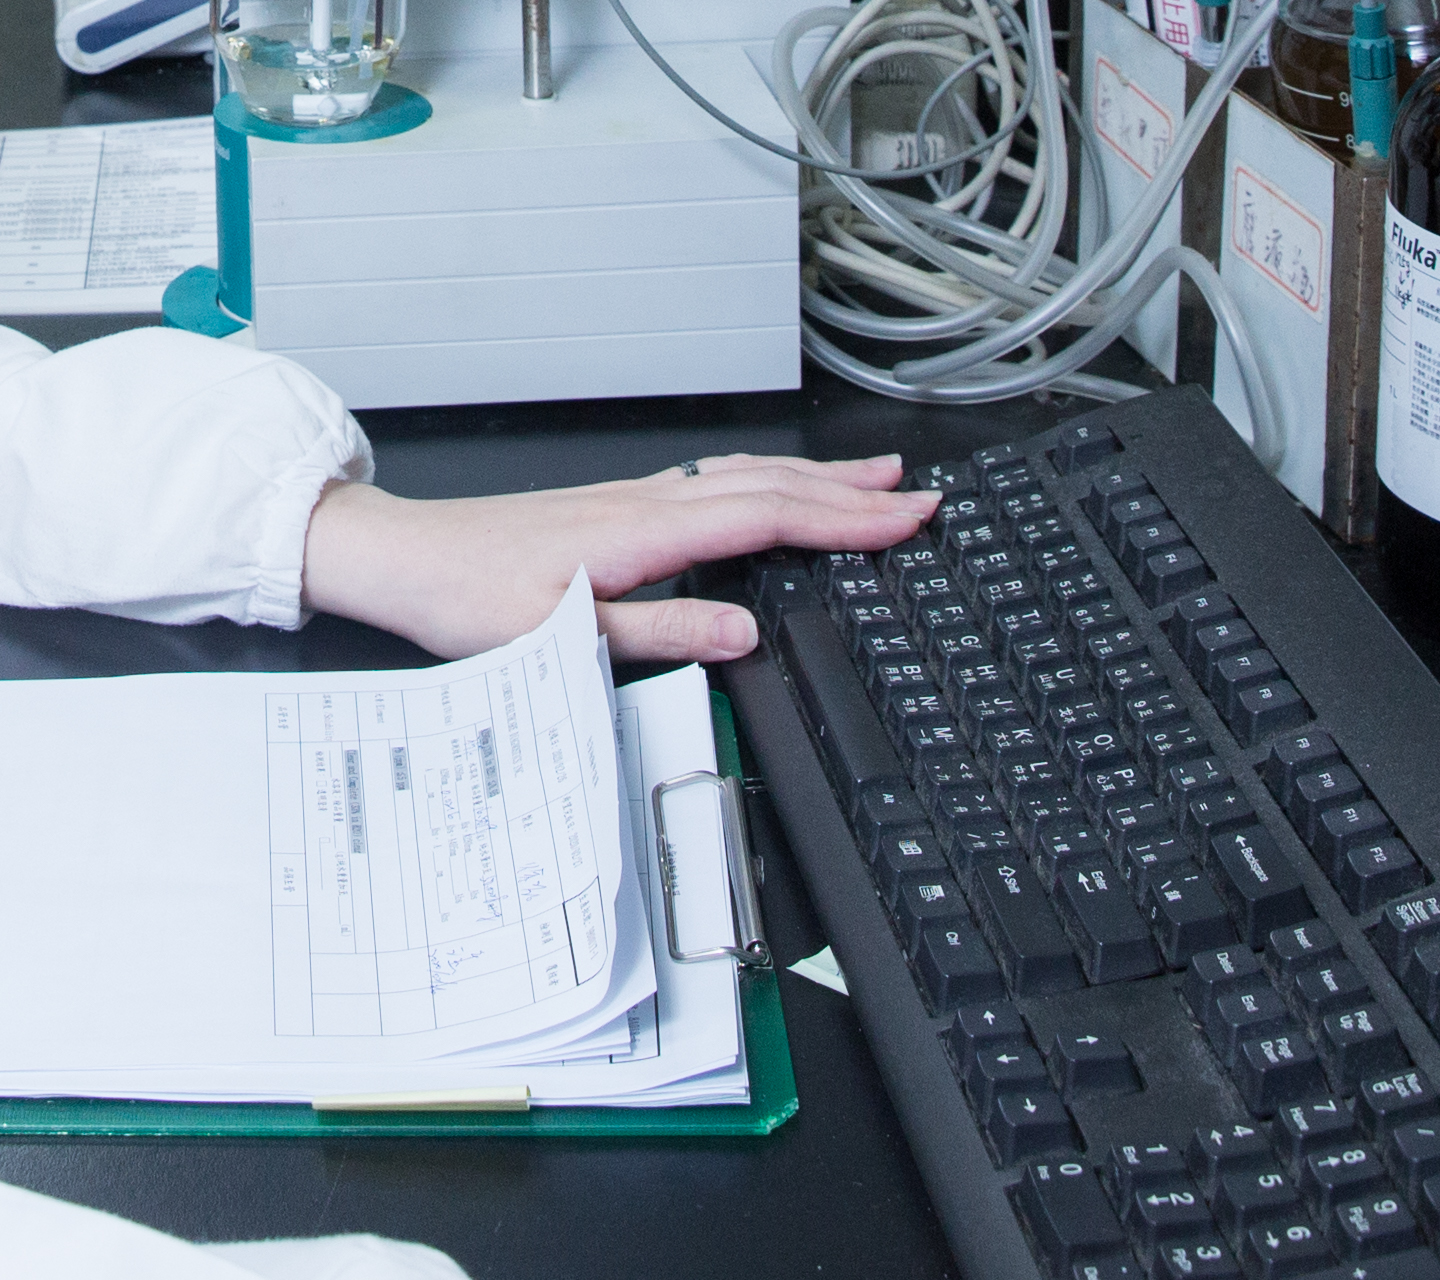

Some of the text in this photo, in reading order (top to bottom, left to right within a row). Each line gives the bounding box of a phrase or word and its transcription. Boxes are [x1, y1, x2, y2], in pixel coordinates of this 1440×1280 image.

[1391, 221, 1438, 271] Fluka
[1110, 474, 1122, 484] F1
[959, 501, 976, 513] Q
[1129, 500, 1141, 511] F2
[974, 526, 991, 540] W
[1147, 527, 1159, 537] F3
[915, 551, 933, 561] S
[989, 552, 1007, 563] E
[1165, 553, 1178, 563] F4
[858, 579, 877, 589] X
[929, 578, 948, 588] D
[1004, 580, 1023, 591] R
[1059, 580, 1071, 588] 5
[1195, 597, 1209, 608] F5
[872, 606, 891, 616] C
[945, 605, 964, 616] F
[1022, 609, 1040, 619] T
[1075, 609, 1088, 617] 6
[1216, 624, 1228, 636] F6
[889, 635, 908, 646] V
[961, 635, 980, 647] G
[1039, 638, 1057, 648] Y
[1237, 656, 1251, 667] F7
[902, 665, 921, 675] B
[976, 664, 995, 676] H
[1056, 668, 1075, 679] U
[1114, 668, 1127, 676] 8
[1259, 687, 1273, 699] F8
[919, 695, 938, 707] N
[993, 697, 1013, 706] J
[1134, 700, 1147, 708] 9
[933, 726, 952, 738] M
[1012, 728, 1033, 739] K
[1093, 734, 1113, 746] O
[1296, 737, 1310, 748] F9
[1029, 761, 1049, 772] L
[1114, 768, 1134, 779] P
[1318, 772, 1335, 788] F10
[1342, 807, 1360, 823] F11
[1369, 845, 1387, 864] F12
[1240, 846, 1269, 882] Backspace
[1090, 869, 1108, 890] Enter
[1412, 900, 1431, 922] Screen
[945, 931, 961, 945] Ctrl
[1293, 927, 1313, 949] Insert
[1216, 952, 1234, 974] Delete
[1319, 968, 1339, 992] Home
[1241, 994, 1259, 1012] End
[1339, 1015, 1353, 1030] Up
[1354, 1010, 1373, 1033] Page
[1260, 1040, 1280, 1063] Down
[1276, 1037, 1294, 1059] Page
[1392, 1076, 1411, 1098] Lock
[1404, 1073, 1423, 1094] Num
[1313, 1099, 1337, 1112] 7
[1289, 1106, 1309, 1131] Home
[1232, 1124, 1255, 1139] 4
[1122, 1145, 1141, 1165] End
[1146, 1143, 1169, 1156] 1
[1342, 1149, 1367, 1165] 8
[1059, 1162, 1083, 1176] 0
[1258, 1173, 1283, 1188] 5
[1169, 1192, 1195, 1207] 2
[1373, 1199, 1399, 1216] 9
[1286, 1225, 1312, 1241] 6
[1196, 1245, 1221, 1260] 3
